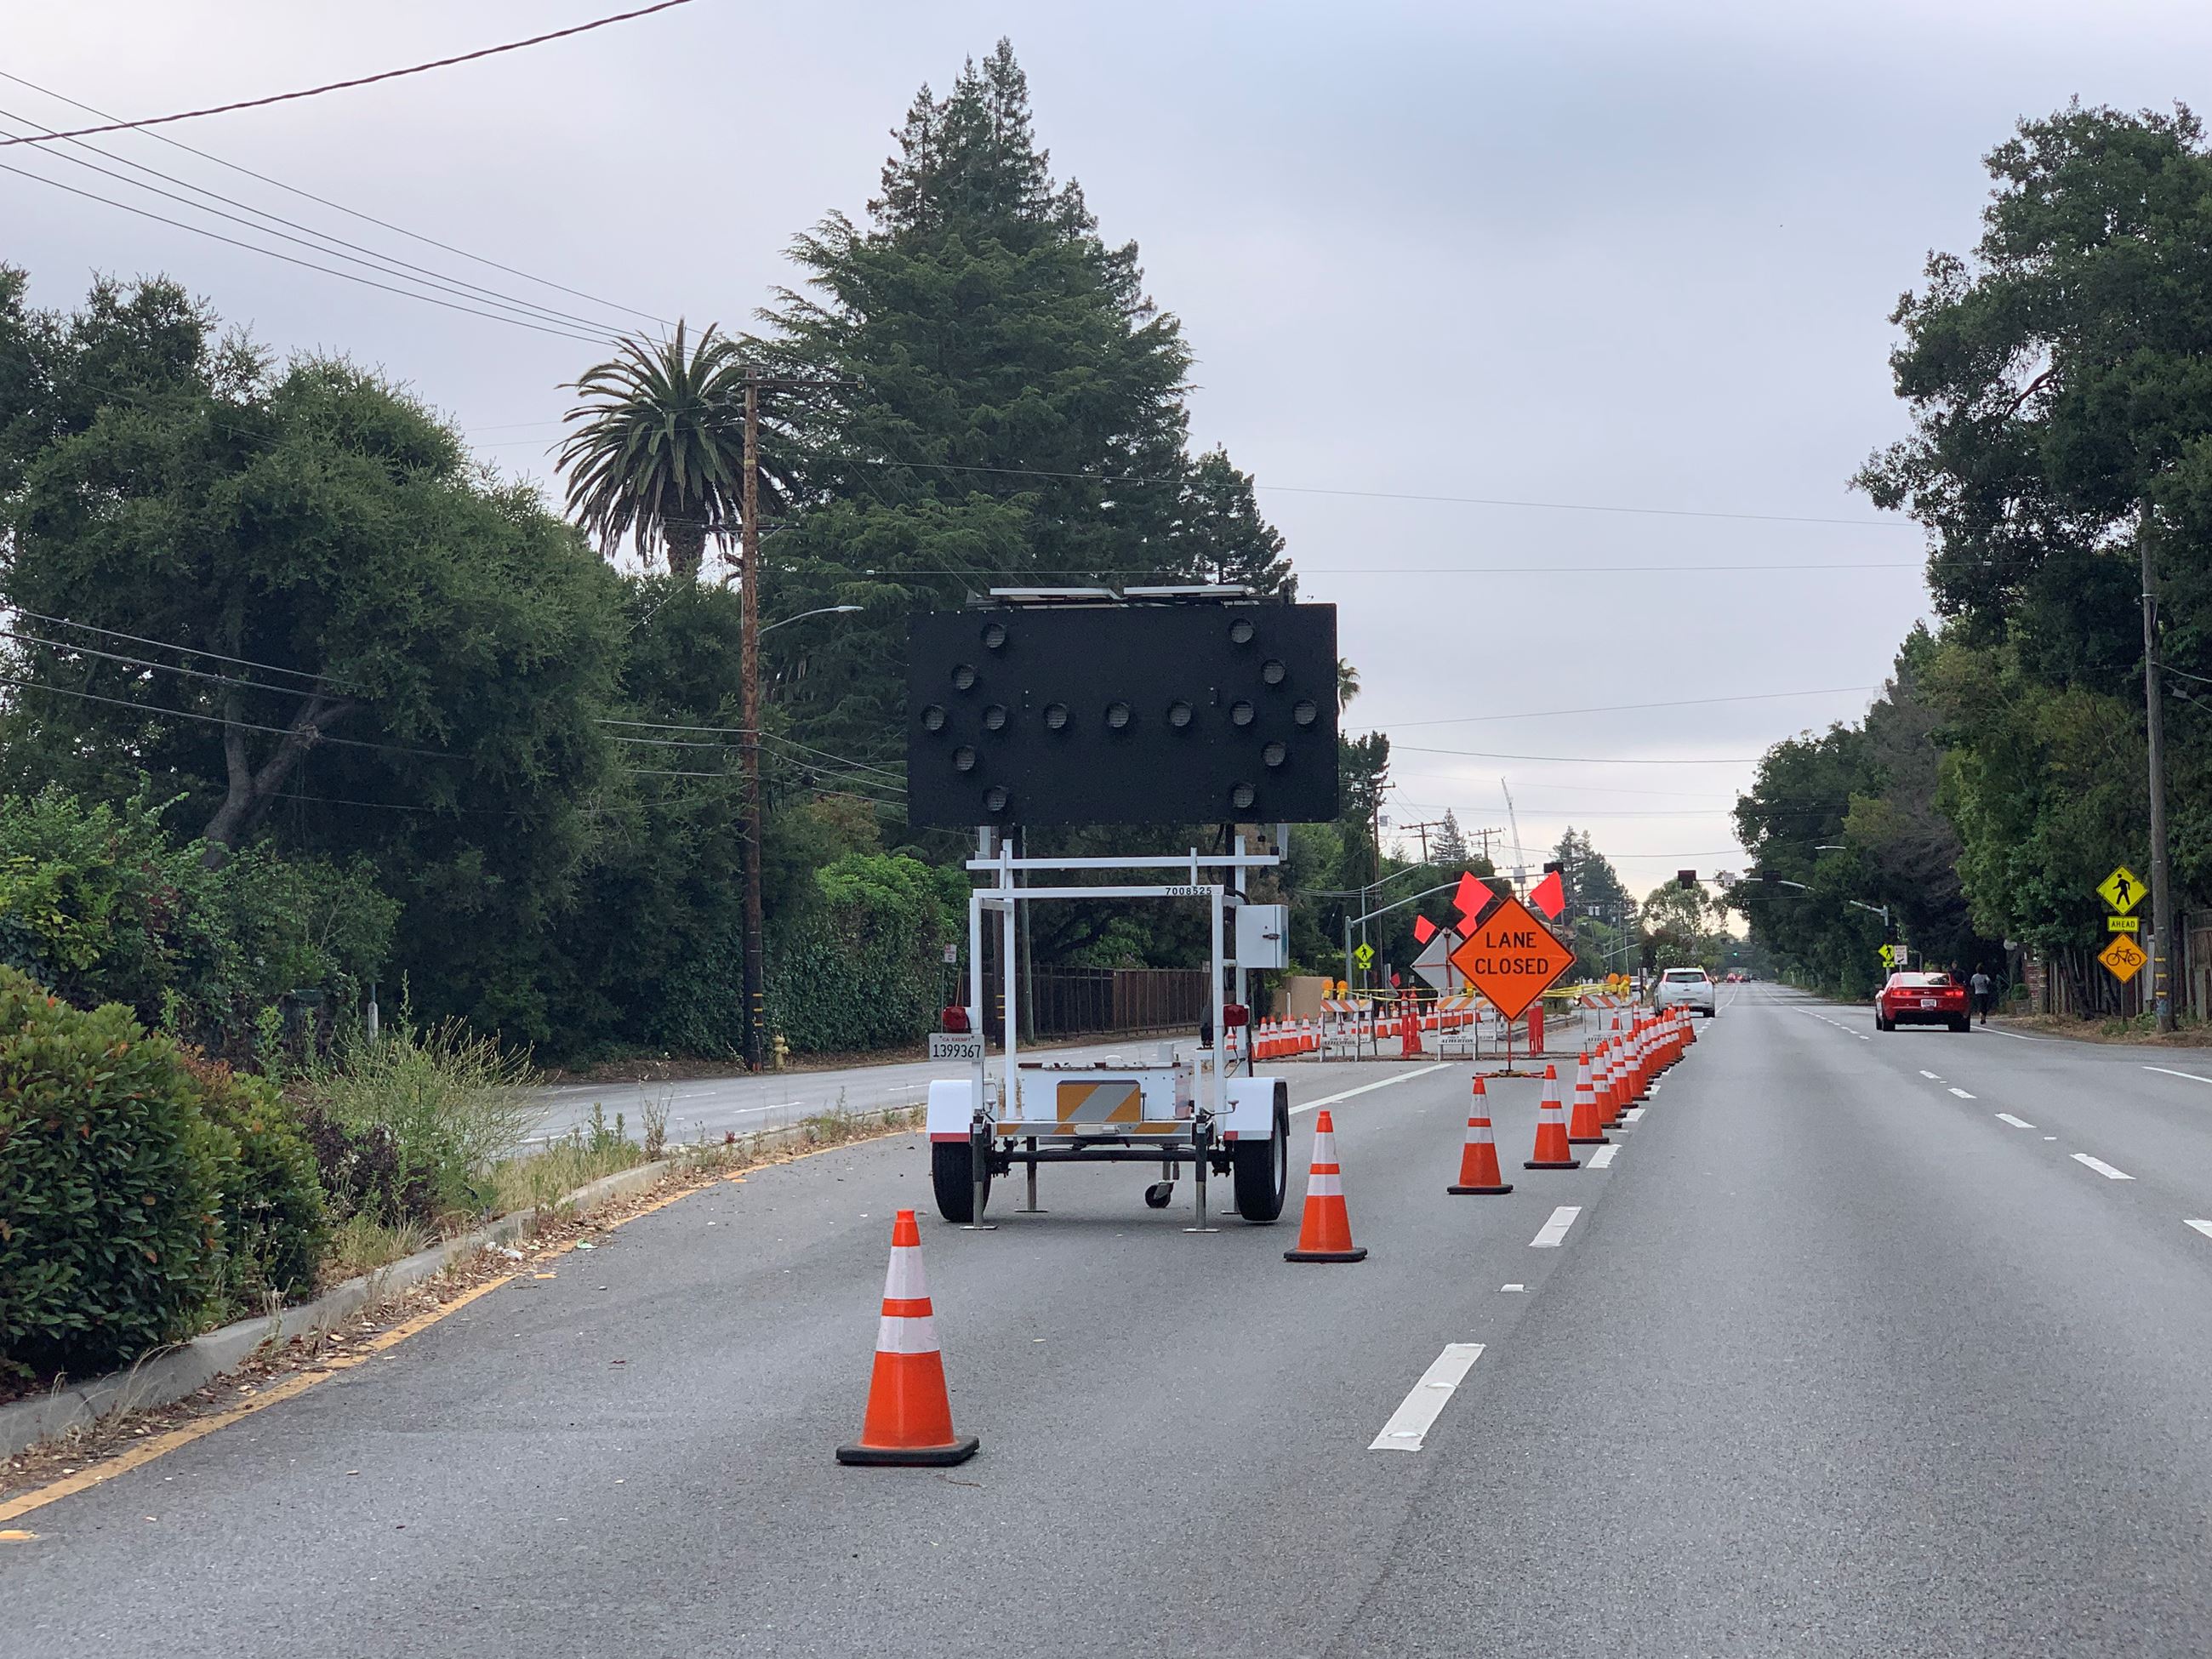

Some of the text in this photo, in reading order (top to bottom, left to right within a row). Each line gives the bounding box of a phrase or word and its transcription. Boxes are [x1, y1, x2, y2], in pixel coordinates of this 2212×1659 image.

[1166, 887, 1211, 895] 7008525
[1486, 932, 1537, 949] LANE
[1474, 958, 1548, 975] CLOSED
[932, 1044, 981, 1058] 1399367
